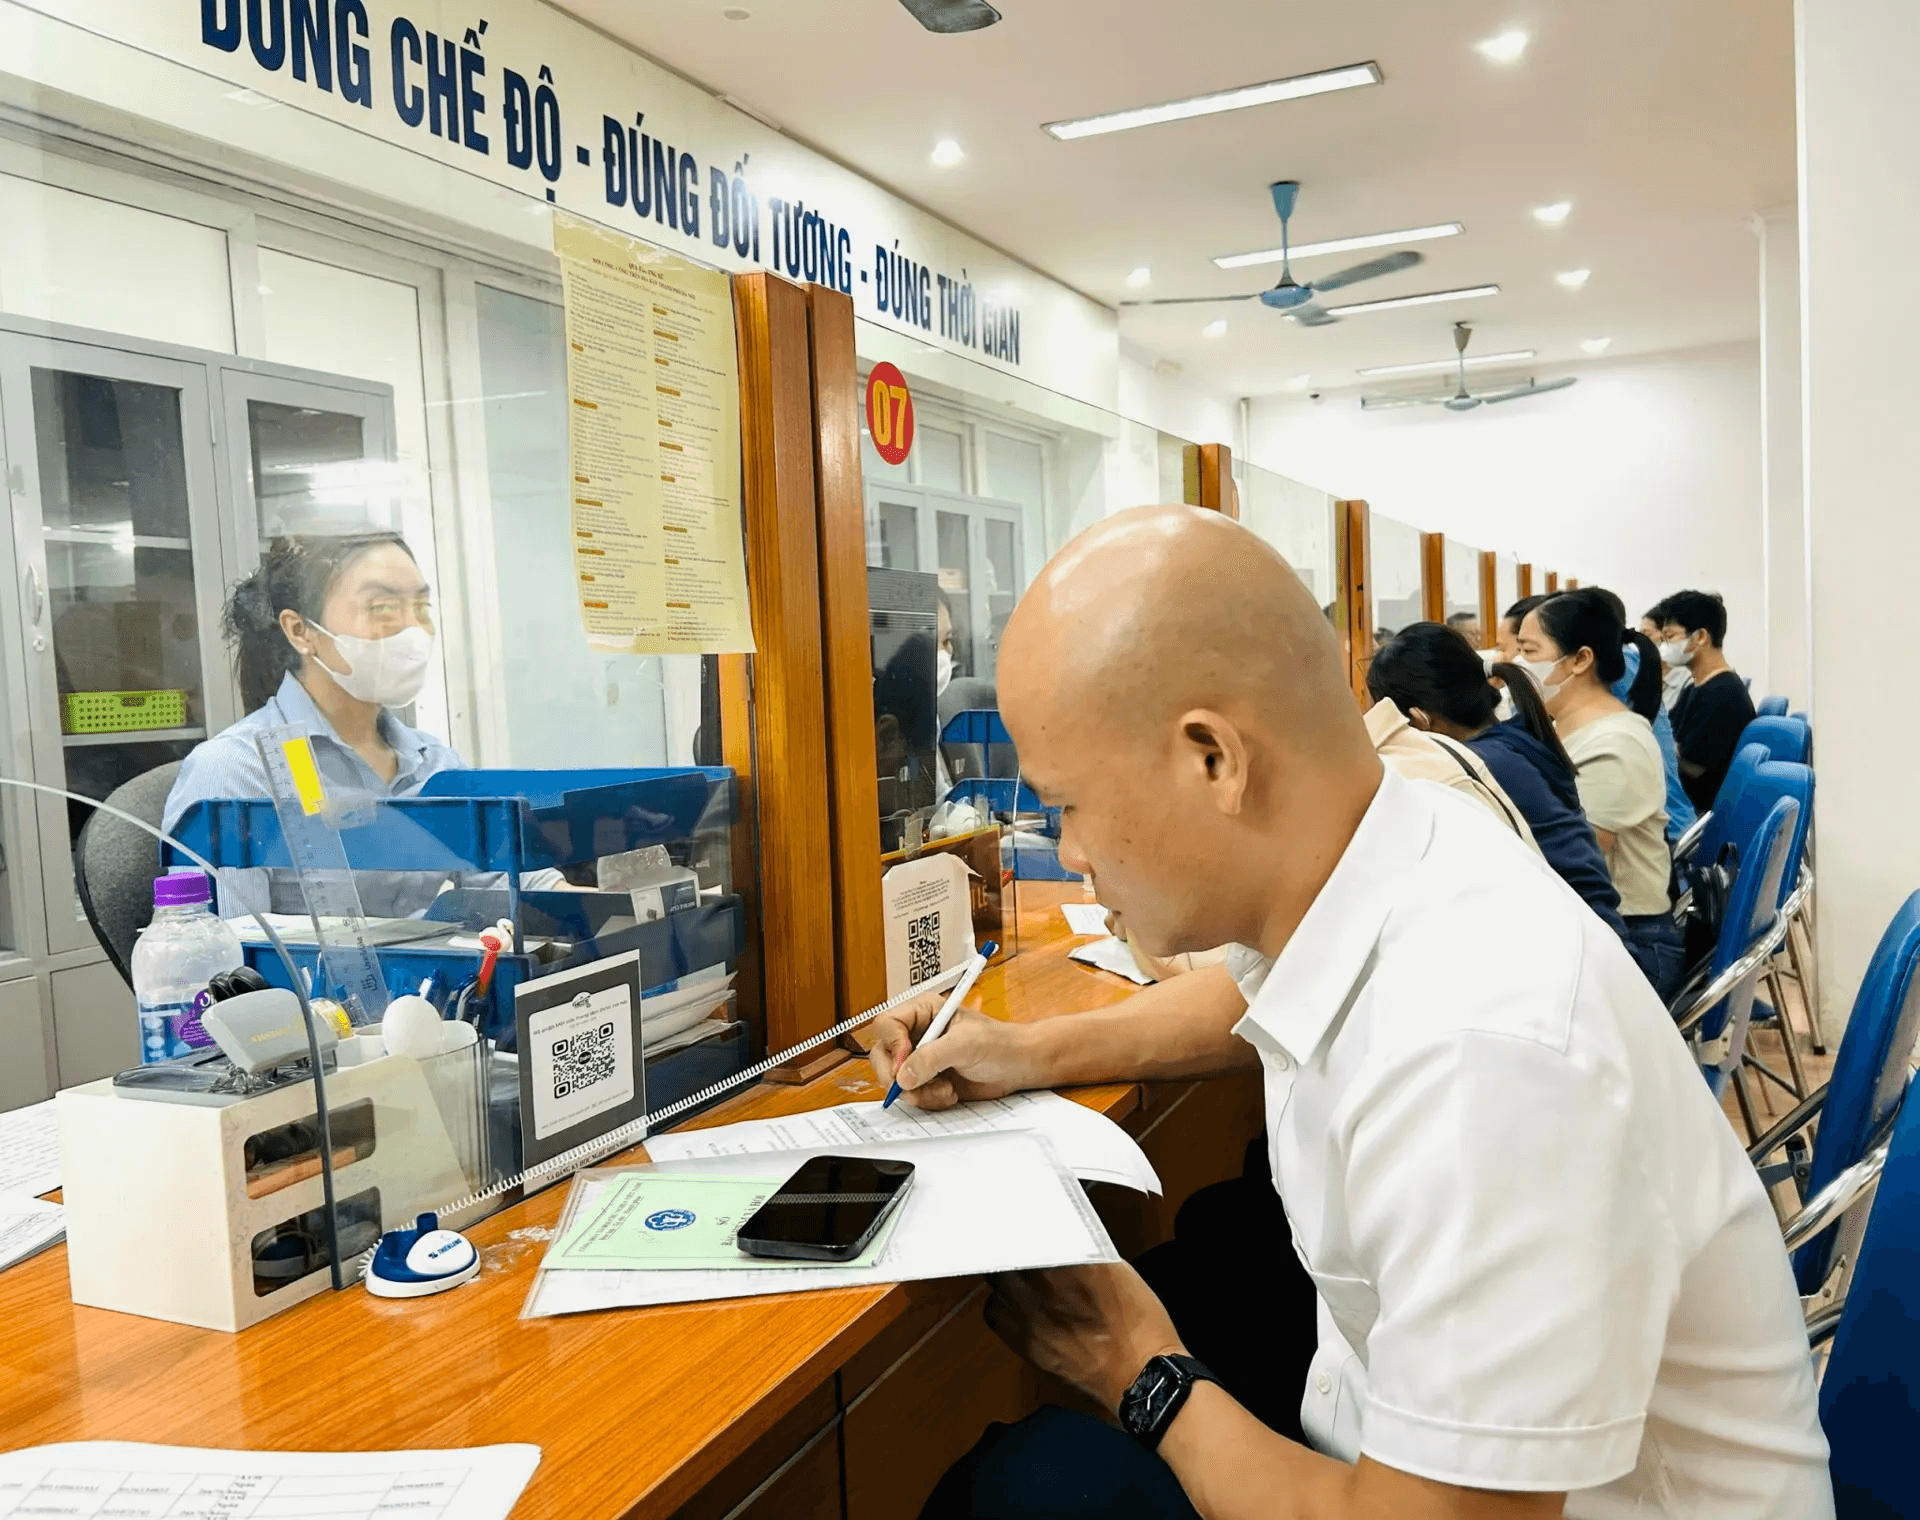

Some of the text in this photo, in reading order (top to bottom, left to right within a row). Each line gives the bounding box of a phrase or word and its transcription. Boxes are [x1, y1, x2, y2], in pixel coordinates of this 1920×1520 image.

[390, 19, 490, 156] CHẾ
[503, 64, 562, 203] ĐỘ
[576, 145, 591, 166] -
[603, 111, 700, 239] ĐÚNG
[709, 153, 760, 263] ĐỐI
[860, 269, 868, 283] -
[876, 238, 931, 331] ĐÚNG
[937, 268, 977, 349] THỜI
[982, 301, 1020, 366] GIAN
[873, 380, 908, 450] 07
